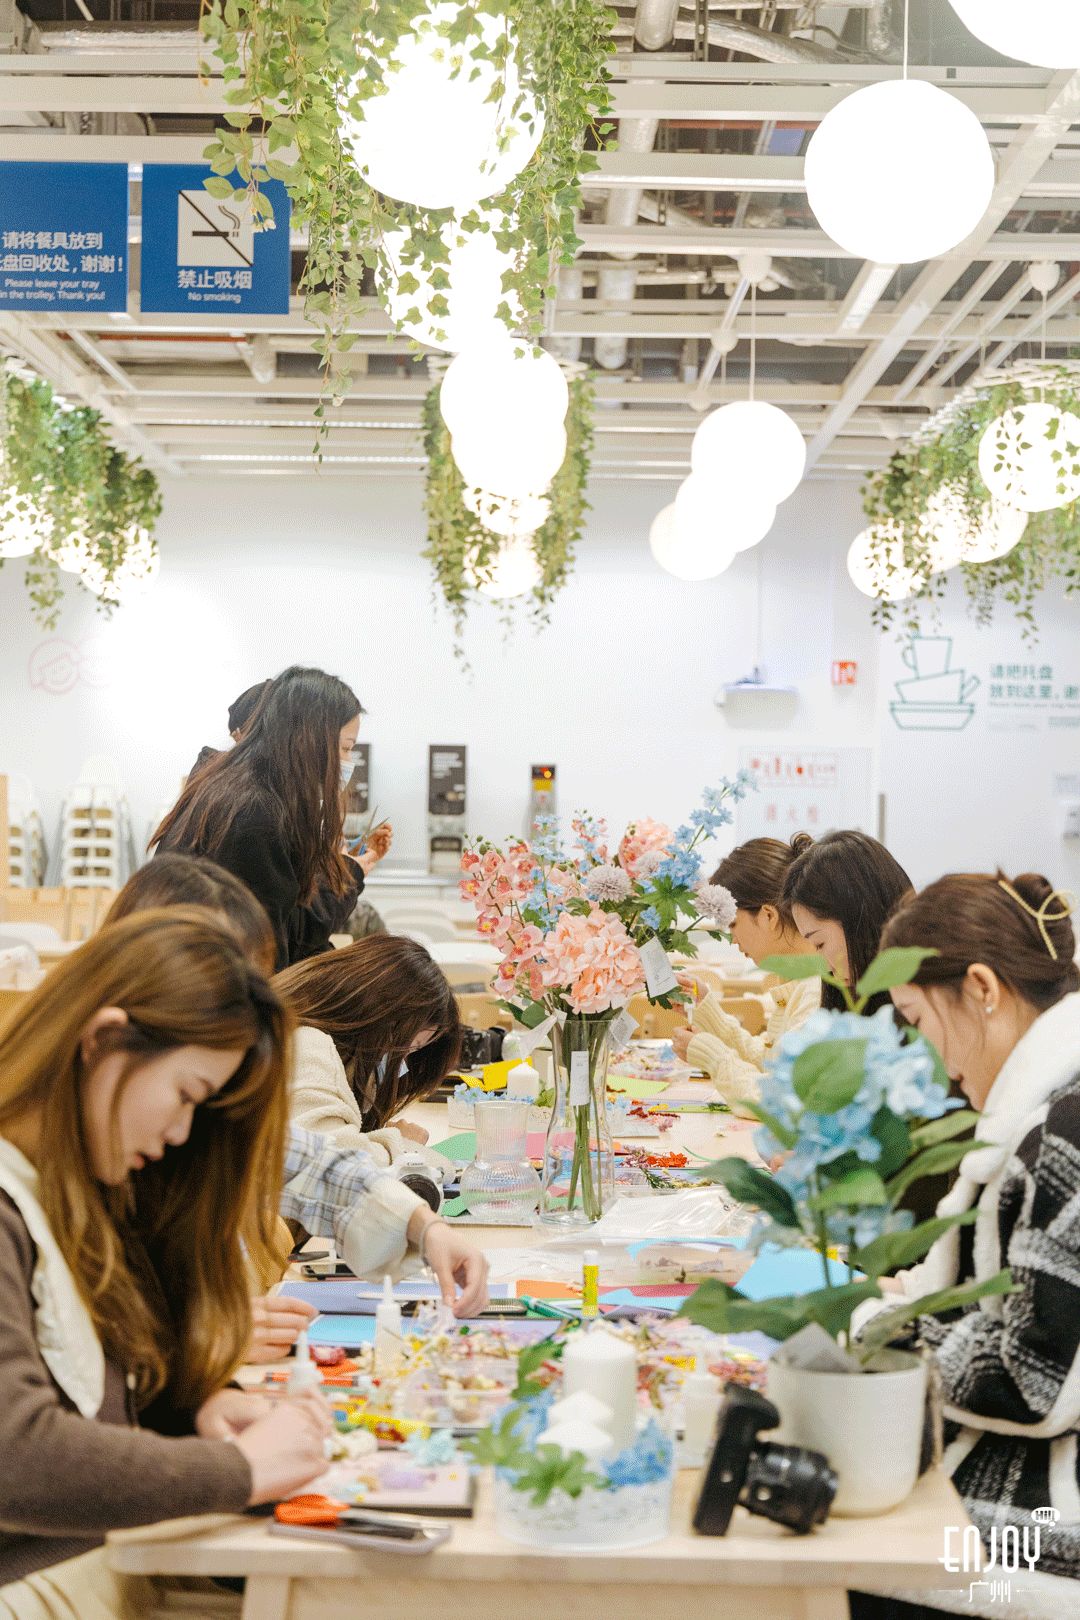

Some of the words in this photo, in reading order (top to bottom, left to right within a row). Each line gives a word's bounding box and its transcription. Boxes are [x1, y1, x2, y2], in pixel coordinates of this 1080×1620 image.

[2, 232, 103, 250] 请将餐具放到
[0, 254, 123, 273] 盘回收处，谢谢！
[5, 279, 33, 288] Please
[35, 279, 58, 288] leave
[60, 280, 80, 290] your
[82, 280, 100, 290] tray
[177, 269, 253, 289] 禁止吸烟
[9, 290, 25, 299] the
[58, 290, 85, 300] Thank
[86, 290, 106, 302] you!
[188, 292, 202, 301] No
[203, 292, 241, 303] smoking
